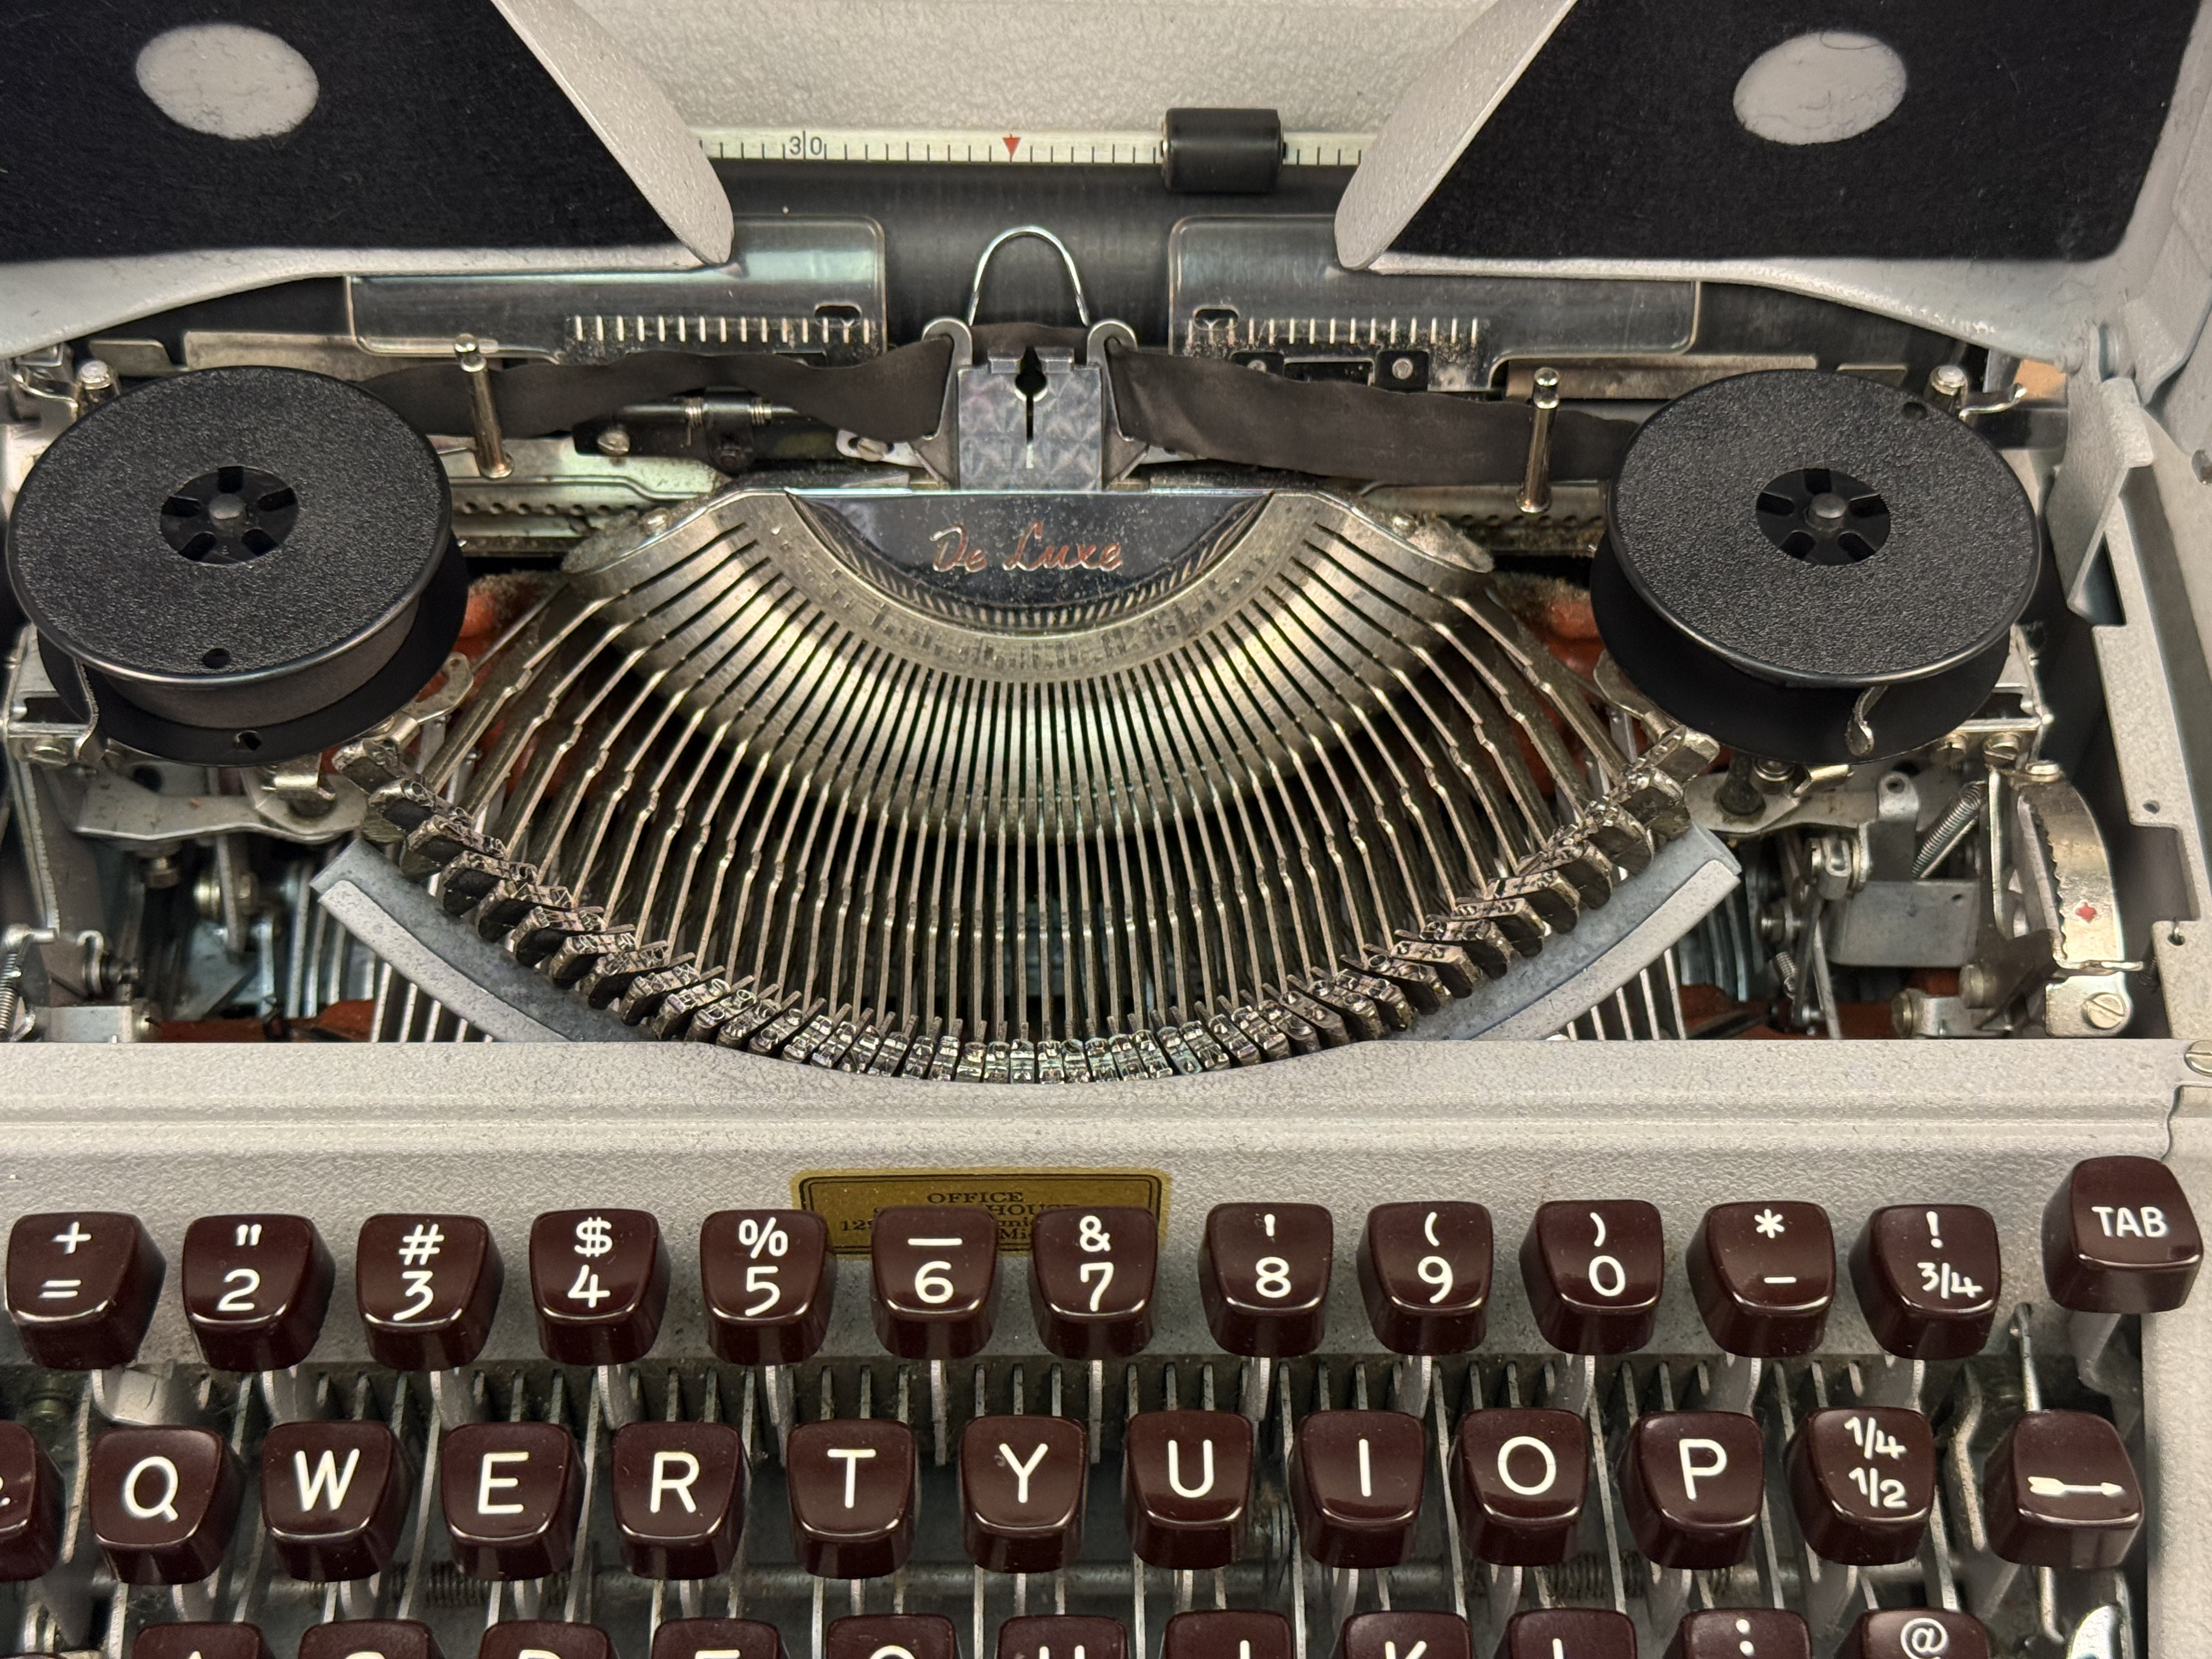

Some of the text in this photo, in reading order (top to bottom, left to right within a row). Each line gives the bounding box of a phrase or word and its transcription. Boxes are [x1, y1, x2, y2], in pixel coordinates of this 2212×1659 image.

[789, 136, 823, 156] 30
[929, 520, 1124, 573] De Luxe
[927, 1192, 1024, 1203] OFFICE
[53, 1221, 92, 1254] +
[574, 1216, 613, 1257] $
[738, 1217, 788, 1259] %
[1079, 1215, 1111, 1252] &
[1424, 1211, 1440, 1246] (
[1590, 1212, 1606, 1247] )
[1926, 1211, 1943, 1248] !
[2091, 1206, 2169, 1238] TAB
[398, 1223, 444, 1266] #
[40, 1279, 81, 1299] =
[217, 1268, 260, 1311] 2
[393, 1271, 433, 1320] 3
[567, 1265, 611, 1308] 4
[745, 1266, 780, 1316] 5
[915, 1261, 953, 1304] 6
[1080, 1262, 1114, 1312] 7
[1255, 1256, 1291, 1298] 8
[1418, 1256, 1453, 1304] 9
[1588, 1255, 1626, 1297] 0
[1917, 1262, 1983, 1299] 3/4
[1844, 1417, 1906, 1459] 1/4
[295, 1448, 360, 1511] W
[477, 1452, 528, 1515] E
[650, 1452, 699, 1514] R
[827, 1449, 876, 1509] T
[999, 1443, 1048, 1504] Y
[1168, 1440, 1214, 1498] U
[1359, 1438, 1372, 1497] I
[1497, 1436, 1556, 1496] O
[1679, 1438, 1727, 1501] P
[1848, 1467, 1908, 1508] 1/2
[123, 1456, 178, 1522] Q
[1900, 1618, 1948, 1659] @
